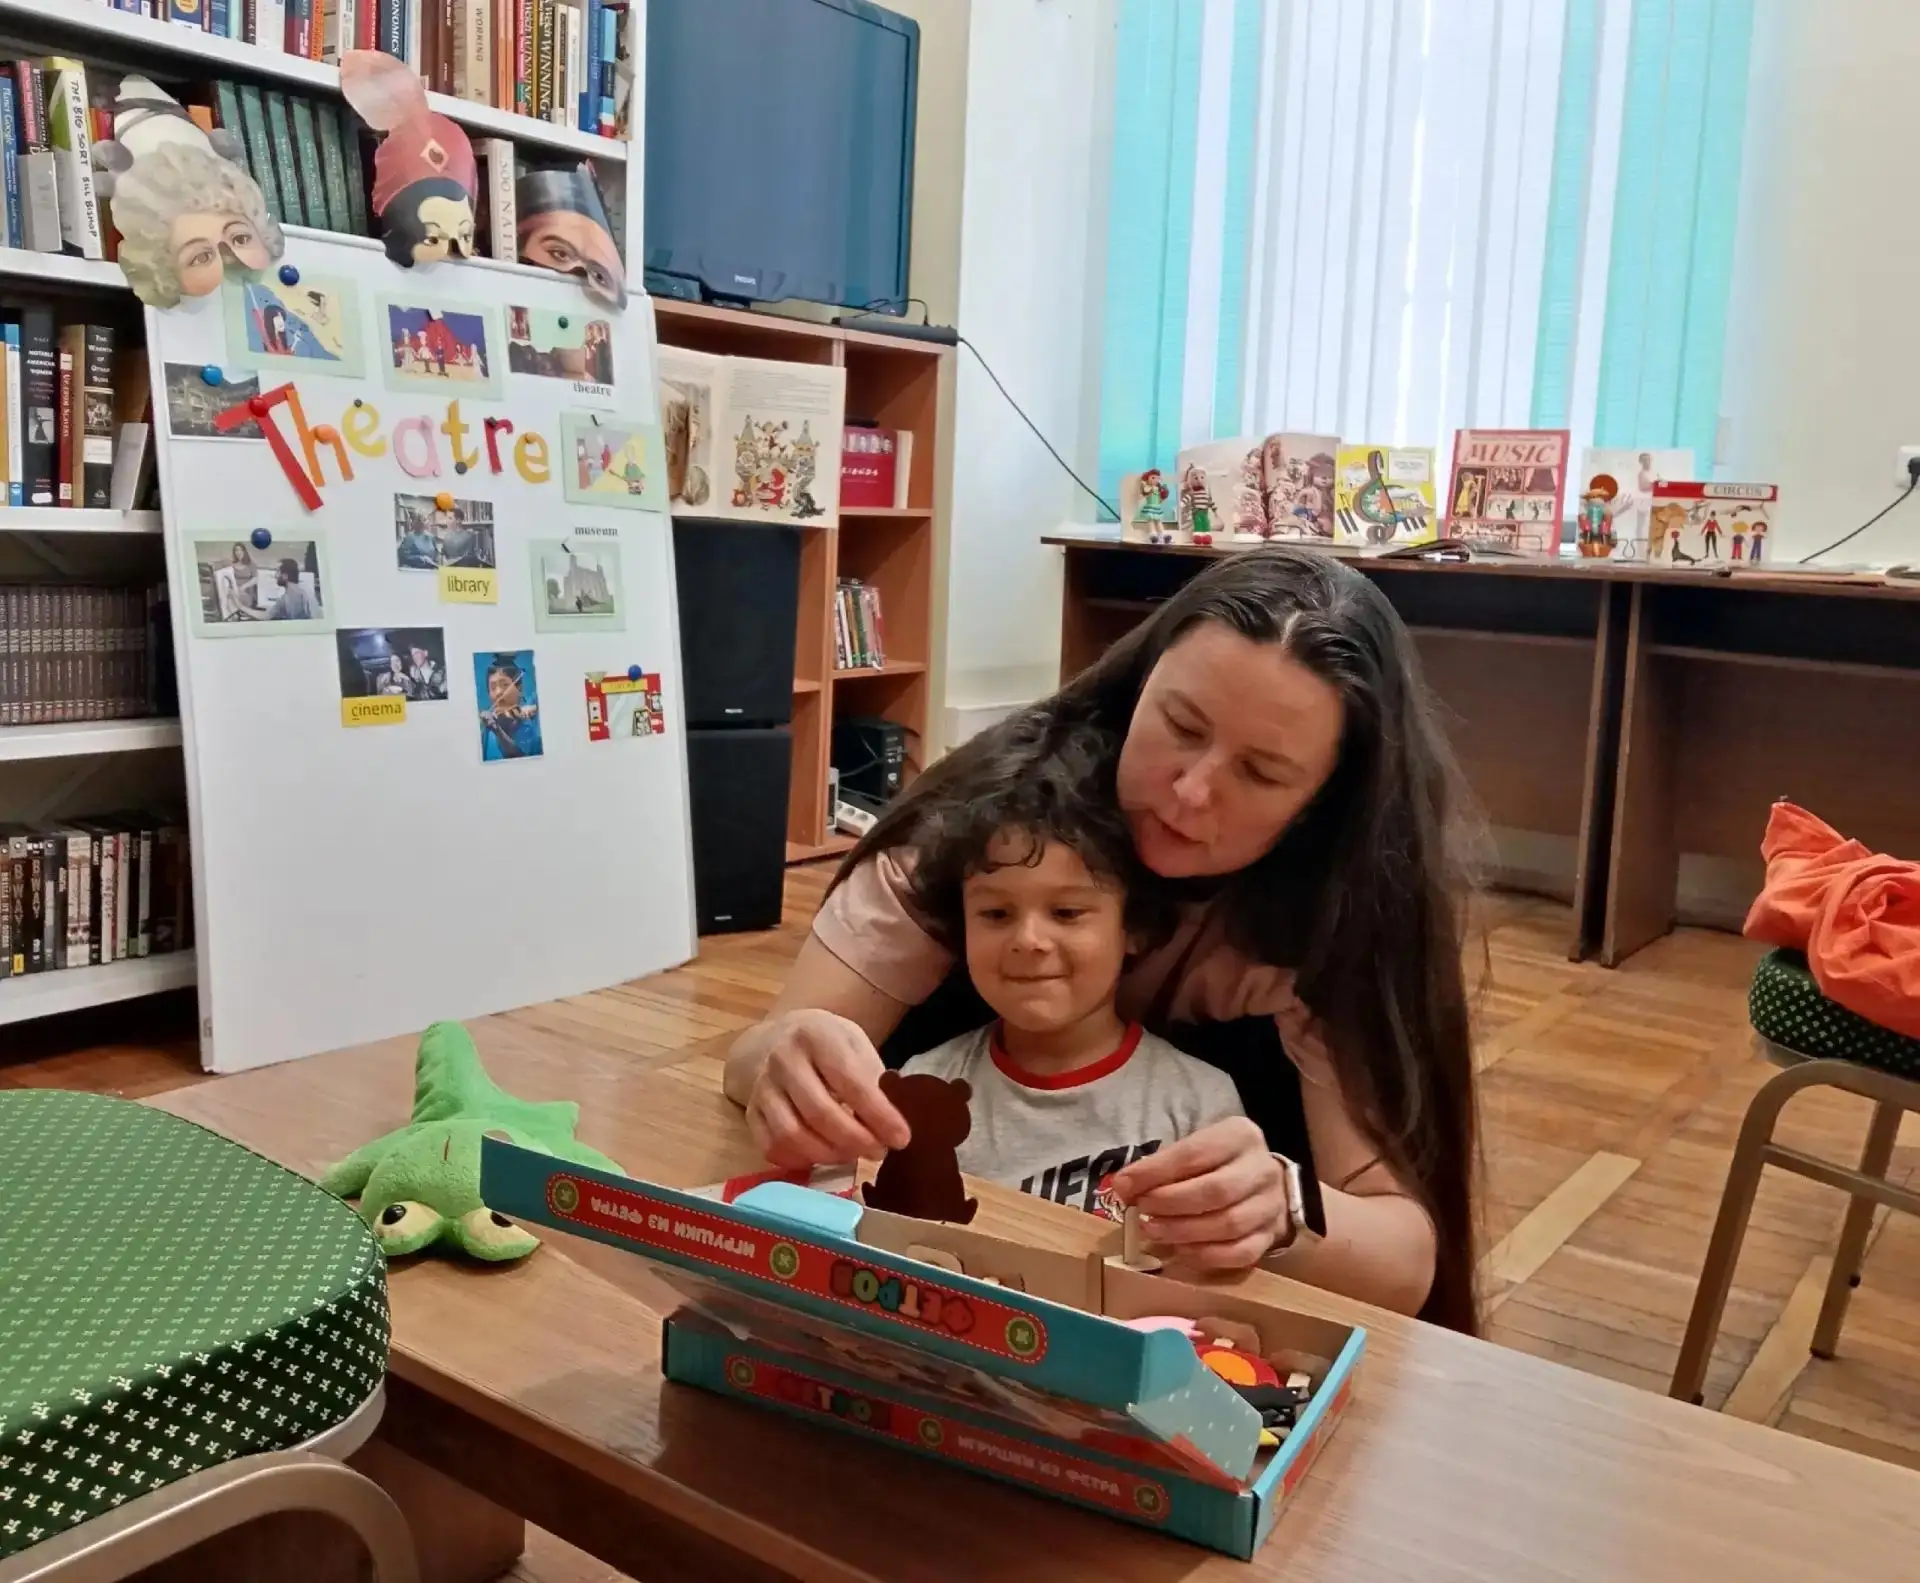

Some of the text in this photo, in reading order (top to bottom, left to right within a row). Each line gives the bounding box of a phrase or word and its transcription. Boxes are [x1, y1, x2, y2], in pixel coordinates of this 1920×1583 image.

[475, 8, 484, 62] WORKING
[540, 40, 552, 110] WINNING
[70, 80, 98, 238] THE BIG SORT BILL BISHOP
[573, 382, 612, 397] theatre
[214, 381, 552, 512] Theatre
[1463, 444, 1556, 463] MUSIC
[1713, 485, 1763, 497] CIRCUS
[574, 526, 619, 537] museum
[447, 575, 490, 597] library
[351, 703, 403, 720] cinema
[590, 1196, 755, 1258] ИГРУШКИ ИЗ ФЕТРА
[957, 1435, 1035, 1469] ИГРУШКИ
[1065, 1469, 1120, 1497] ФЕТРА
